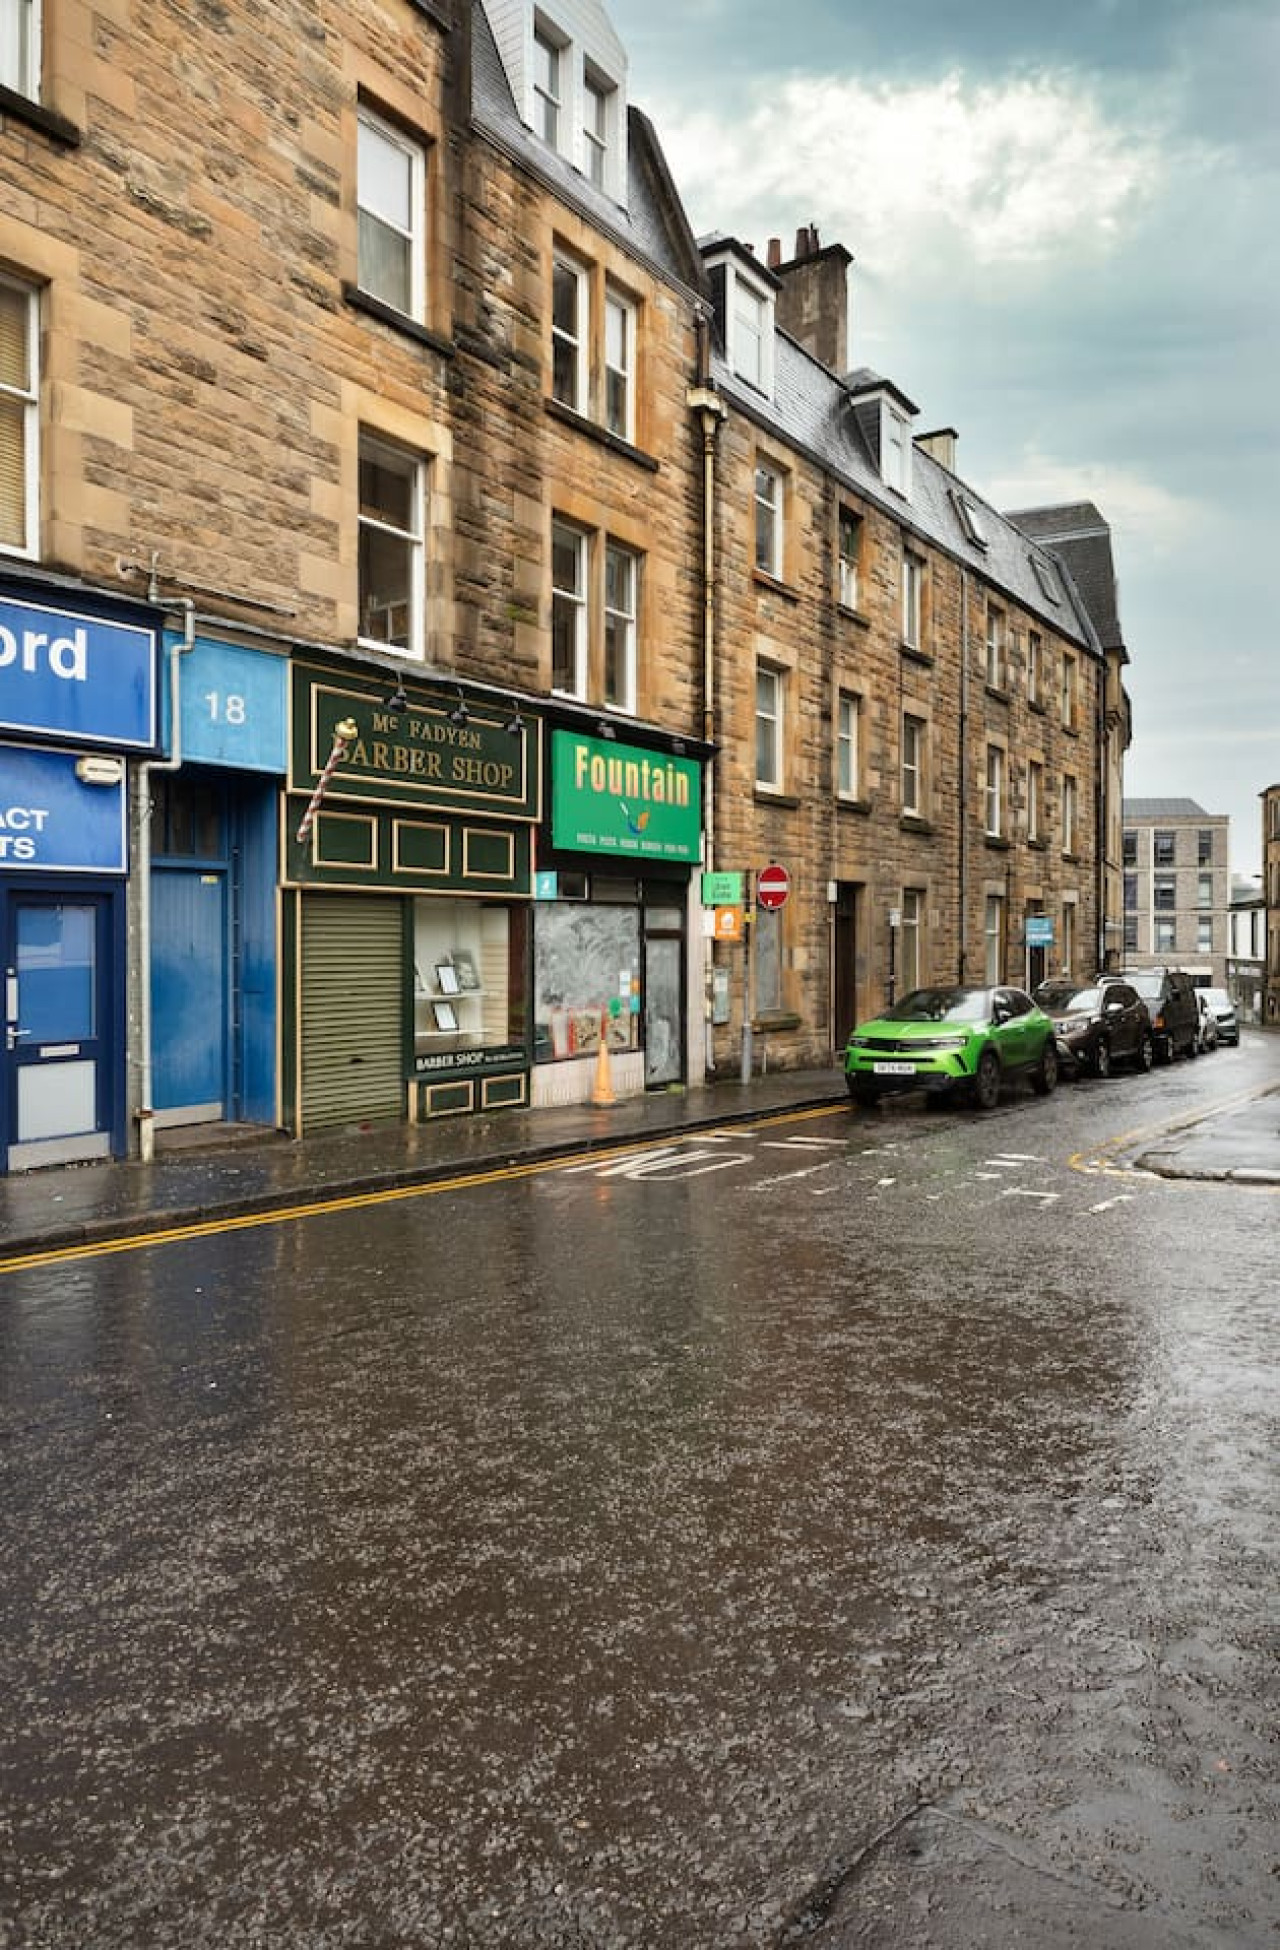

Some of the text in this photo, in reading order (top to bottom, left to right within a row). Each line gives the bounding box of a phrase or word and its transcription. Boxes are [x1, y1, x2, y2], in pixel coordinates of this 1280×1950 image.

[205, 691, 246, 724] 18
[410, 720, 481, 749] FADYEN
[452, 757, 513, 788] SHOP
[575, 744, 690, 806] Fountain
